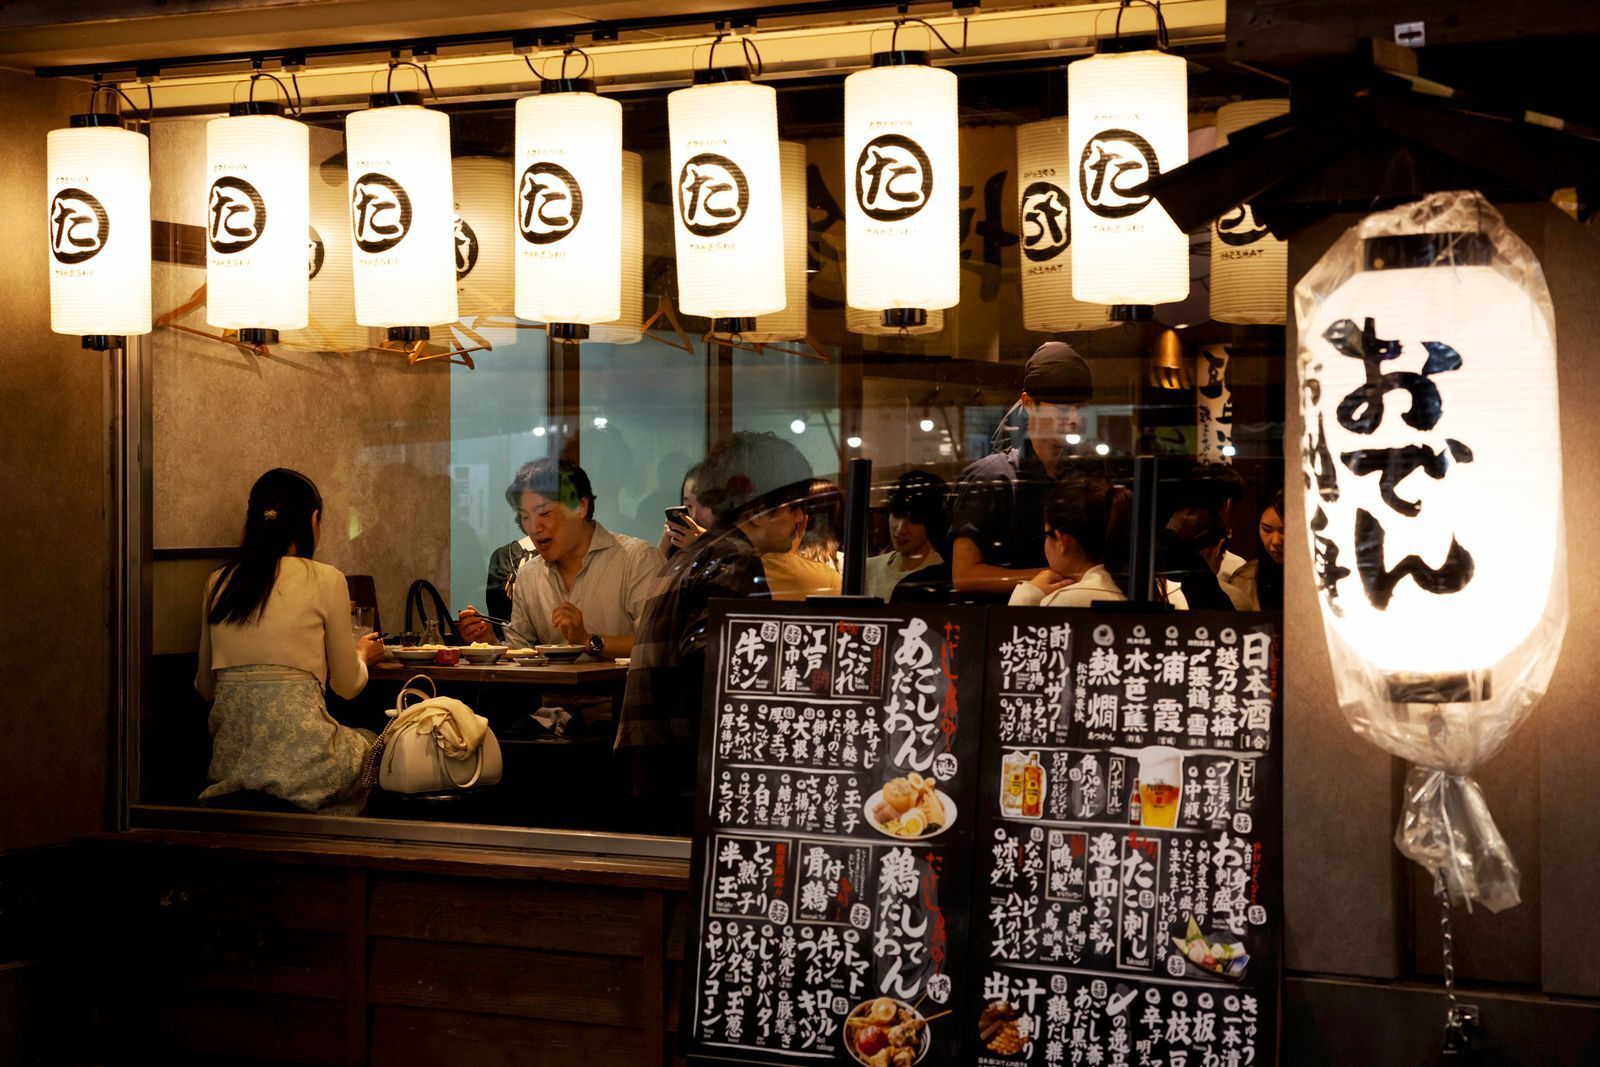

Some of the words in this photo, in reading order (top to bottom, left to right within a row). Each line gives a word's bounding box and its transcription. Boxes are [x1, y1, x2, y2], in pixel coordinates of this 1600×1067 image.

[682, 164, 741, 226] た
[860, 145, 925, 211] た
[1084, 138, 1150, 206] た
[51, 197, 101, 253] た
[209, 186, 257, 242] た
[354, 183, 404, 241] た
[520, 172, 574, 232] た
[1322, 315, 1476, 612] おでん
[735, 627, 768, 690] 牛タン
[1238, 631, 1272, 732] 日本酒
[882, 617, 942, 772] あごだしおでん
[1085, 646, 1123, 732] 熱燗
[1121, 647, 1152, 733] 水芭蕉
[1153, 650, 1189, 734] 浦霞
[1210, 646, 1240, 738] 越乃寒梅
[719, 713, 735, 755] 厚揚げ
[734, 714, 752, 761] ちくわぶ
[752, 713, 770, 759] こんにゃく
[769, 707, 791, 763] 厚焼玉子
[790, 715, 812, 760] 大根
[811, 718, 829, 760] 餅巾着
[827, 717, 842, 763] たけのこ
[860, 718, 882, 769] 牛すじ
[1186, 713, 1210, 737] 雪
[718, 781, 734, 824] ちくわ
[735, 782, 752, 825] はんぺん
[753, 783, 771, 822] 白滝
[822, 783, 840, 829] がんもどき
[1078, 753, 1098, 818] 角ハイボール
[1108, 760, 1122, 808] ハイボール
[1183, 779, 1202, 820] 中瓶
[1238, 761, 1255, 802] ビール
[842, 789, 862, 834] 玉子
[715, 840, 760, 915] 半熟玉子
[800, 846, 845, 914] 骨付き鶏
[990, 836, 1020, 885] ポテトサラダ
[1022, 840, 1044, 893] なめろう
[1088, 832, 1121, 956] 逸品おつまみ
[1122, 848, 1155, 960] たこ刺し
[873, 846, 929, 999] 鶏だしおでん
[702, 933, 727, 1027] ヤングコーン
[778, 936, 798, 978] 焼売
[843, 942, 871, 995] トマト
[724, 990, 745, 1039] 玉葱
[756, 937, 780, 1038] じゃがバター
[1045, 994, 1072, 1067] 鶏だし雑
[1191, 1010, 1220, 1067] 板わ
